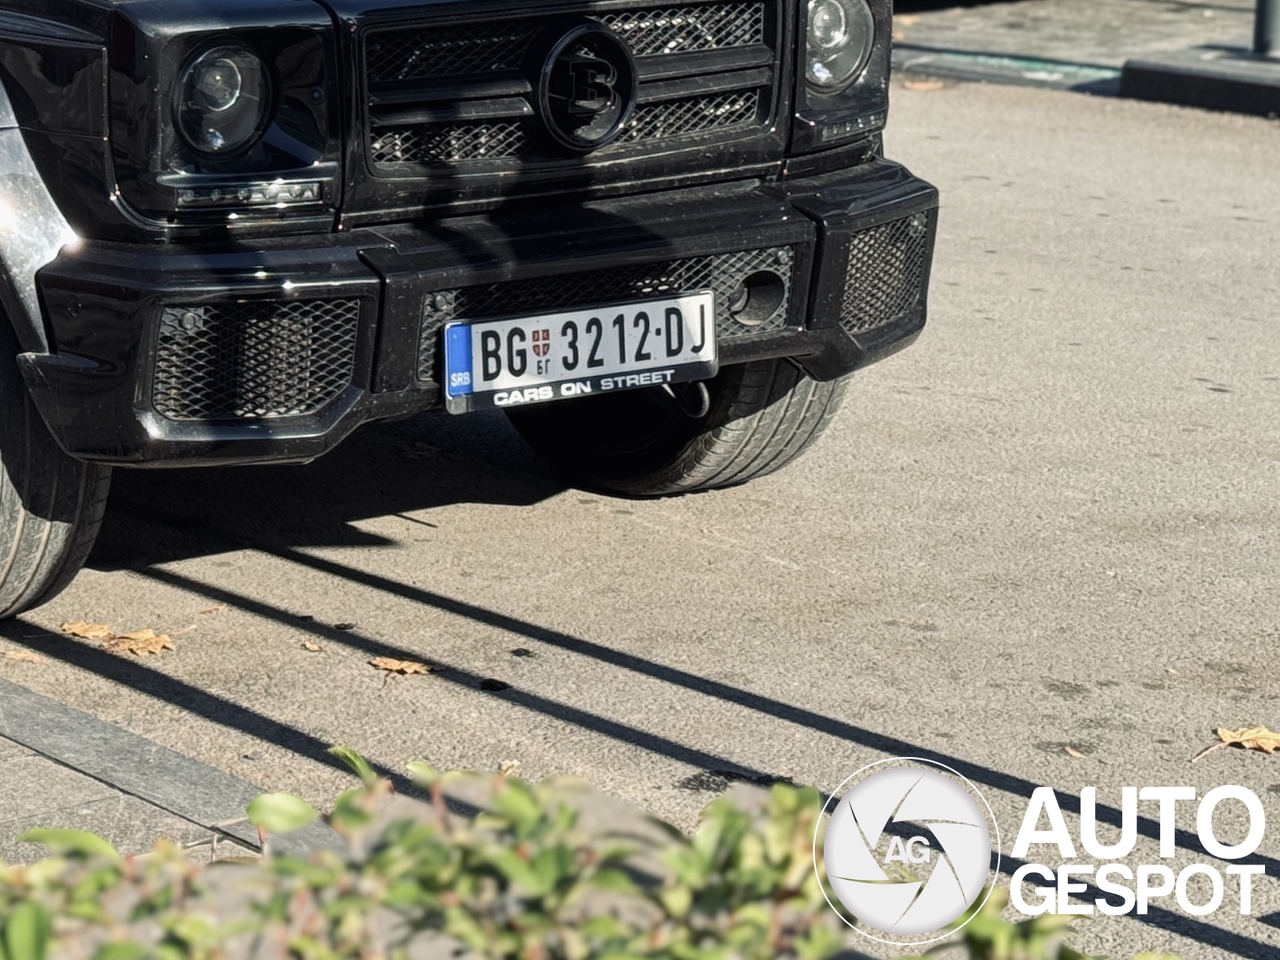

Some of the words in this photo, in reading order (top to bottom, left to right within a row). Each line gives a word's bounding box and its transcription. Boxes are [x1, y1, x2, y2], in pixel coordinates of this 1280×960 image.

[480, 326, 528, 382] BG
[450, 371, 471, 387] SRB
[493, 385, 554, 406] CARS
[560, 379, 592, 396] ON
[600, 369, 675, 391] STREET
